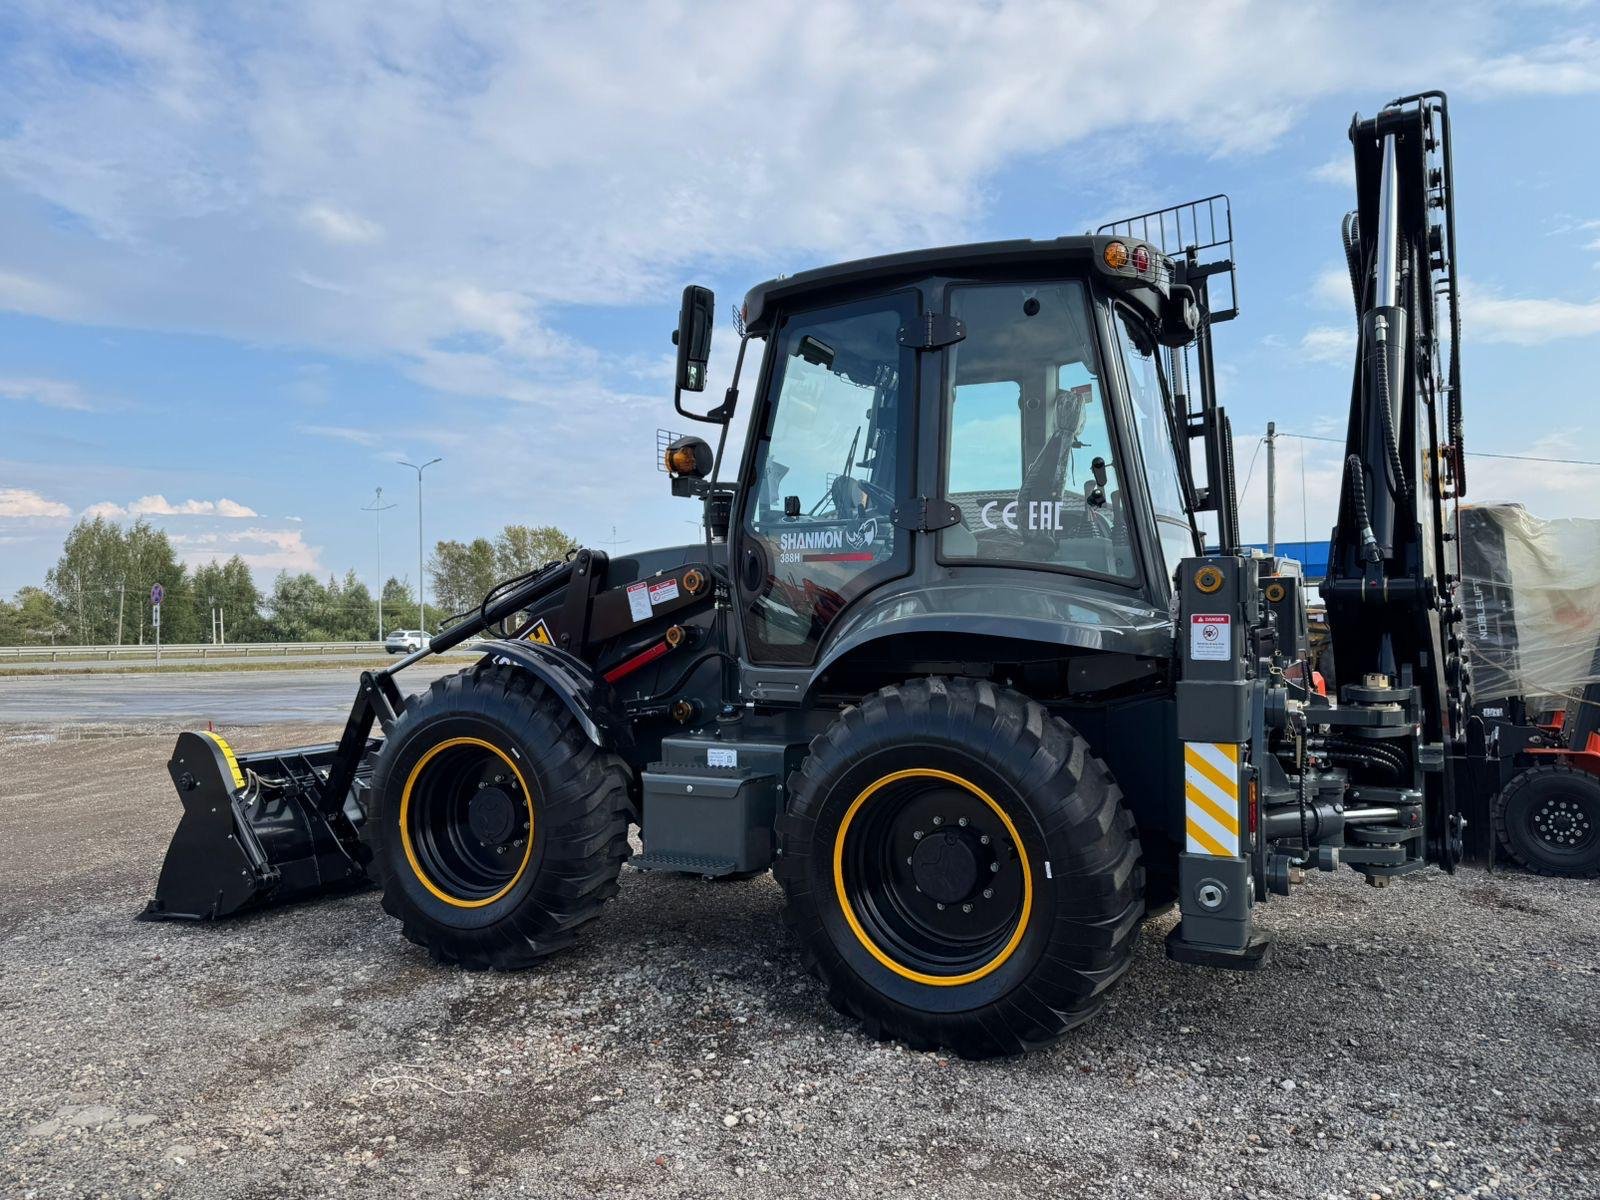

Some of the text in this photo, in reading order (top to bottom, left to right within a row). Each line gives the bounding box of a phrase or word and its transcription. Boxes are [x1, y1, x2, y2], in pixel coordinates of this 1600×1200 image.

[981, 500, 1019, 530] CE
[780, 530, 843, 551] SHANMON
[779, 552, 800, 563] 388H
[1472, 577, 1489, 640] NOBLELIFT
